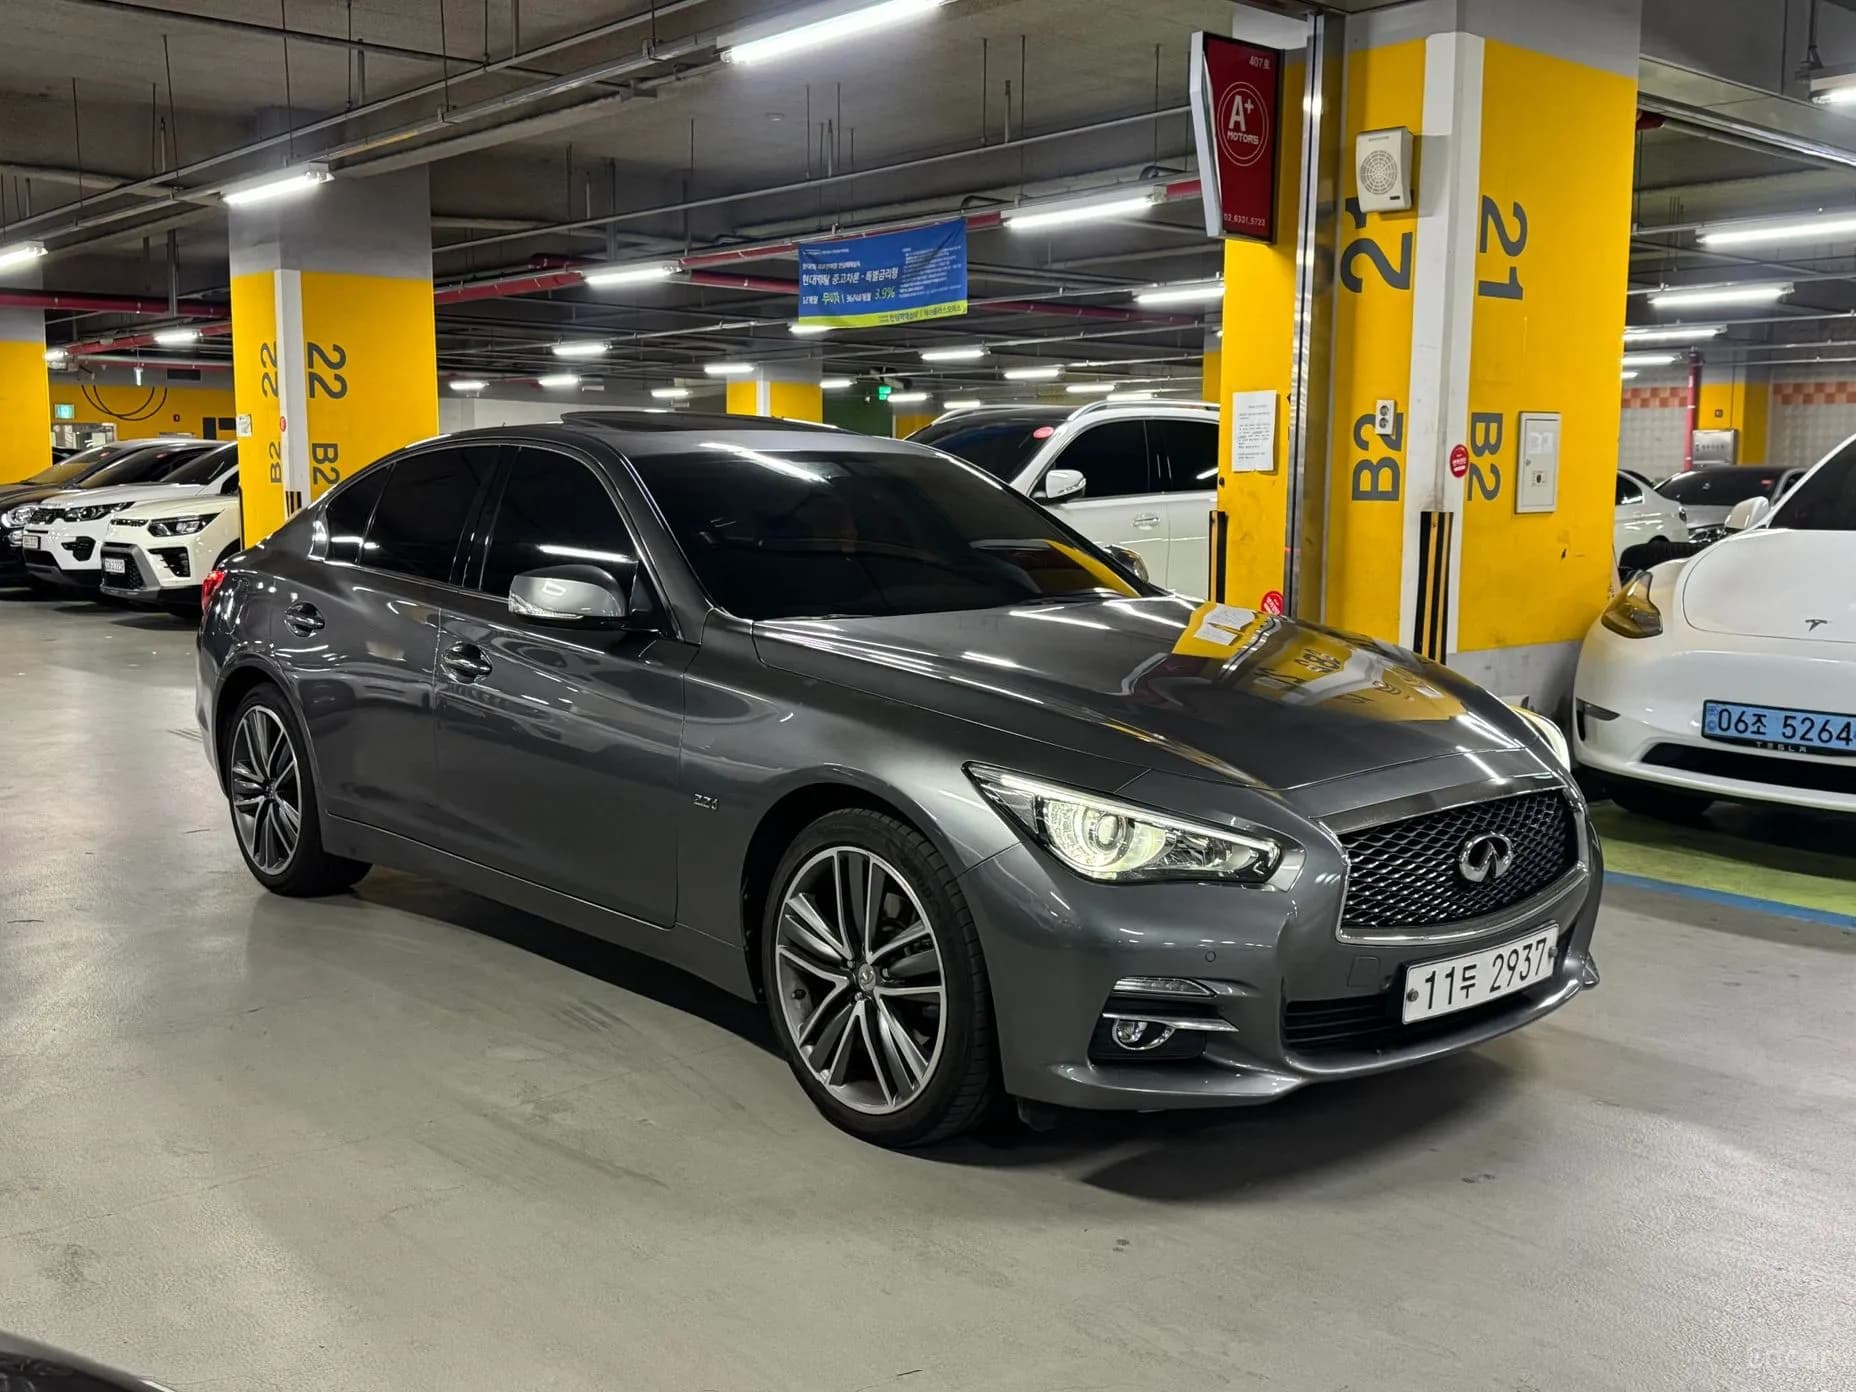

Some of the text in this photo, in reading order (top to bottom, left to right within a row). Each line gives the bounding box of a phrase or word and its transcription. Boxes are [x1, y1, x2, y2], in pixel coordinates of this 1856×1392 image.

[1226, 129, 1259, 145] MOTORS
[1228, 94, 1254, 132] A+
[1478, 195, 1528, 300] 21
[260, 342, 279, 398] 22
[307, 342, 348, 399] 22
[269, 441, 281, 483] B2
[312, 443, 341, 485] B2
[1351, 412, 1404, 502] B2
[1467, 412, 1504, 501] B2
[1717, 708, 1853, 746] 06조 5264
[1756, 741, 1807, 753] TESLA
[1425, 937, 1547, 1010] 11두 2937
